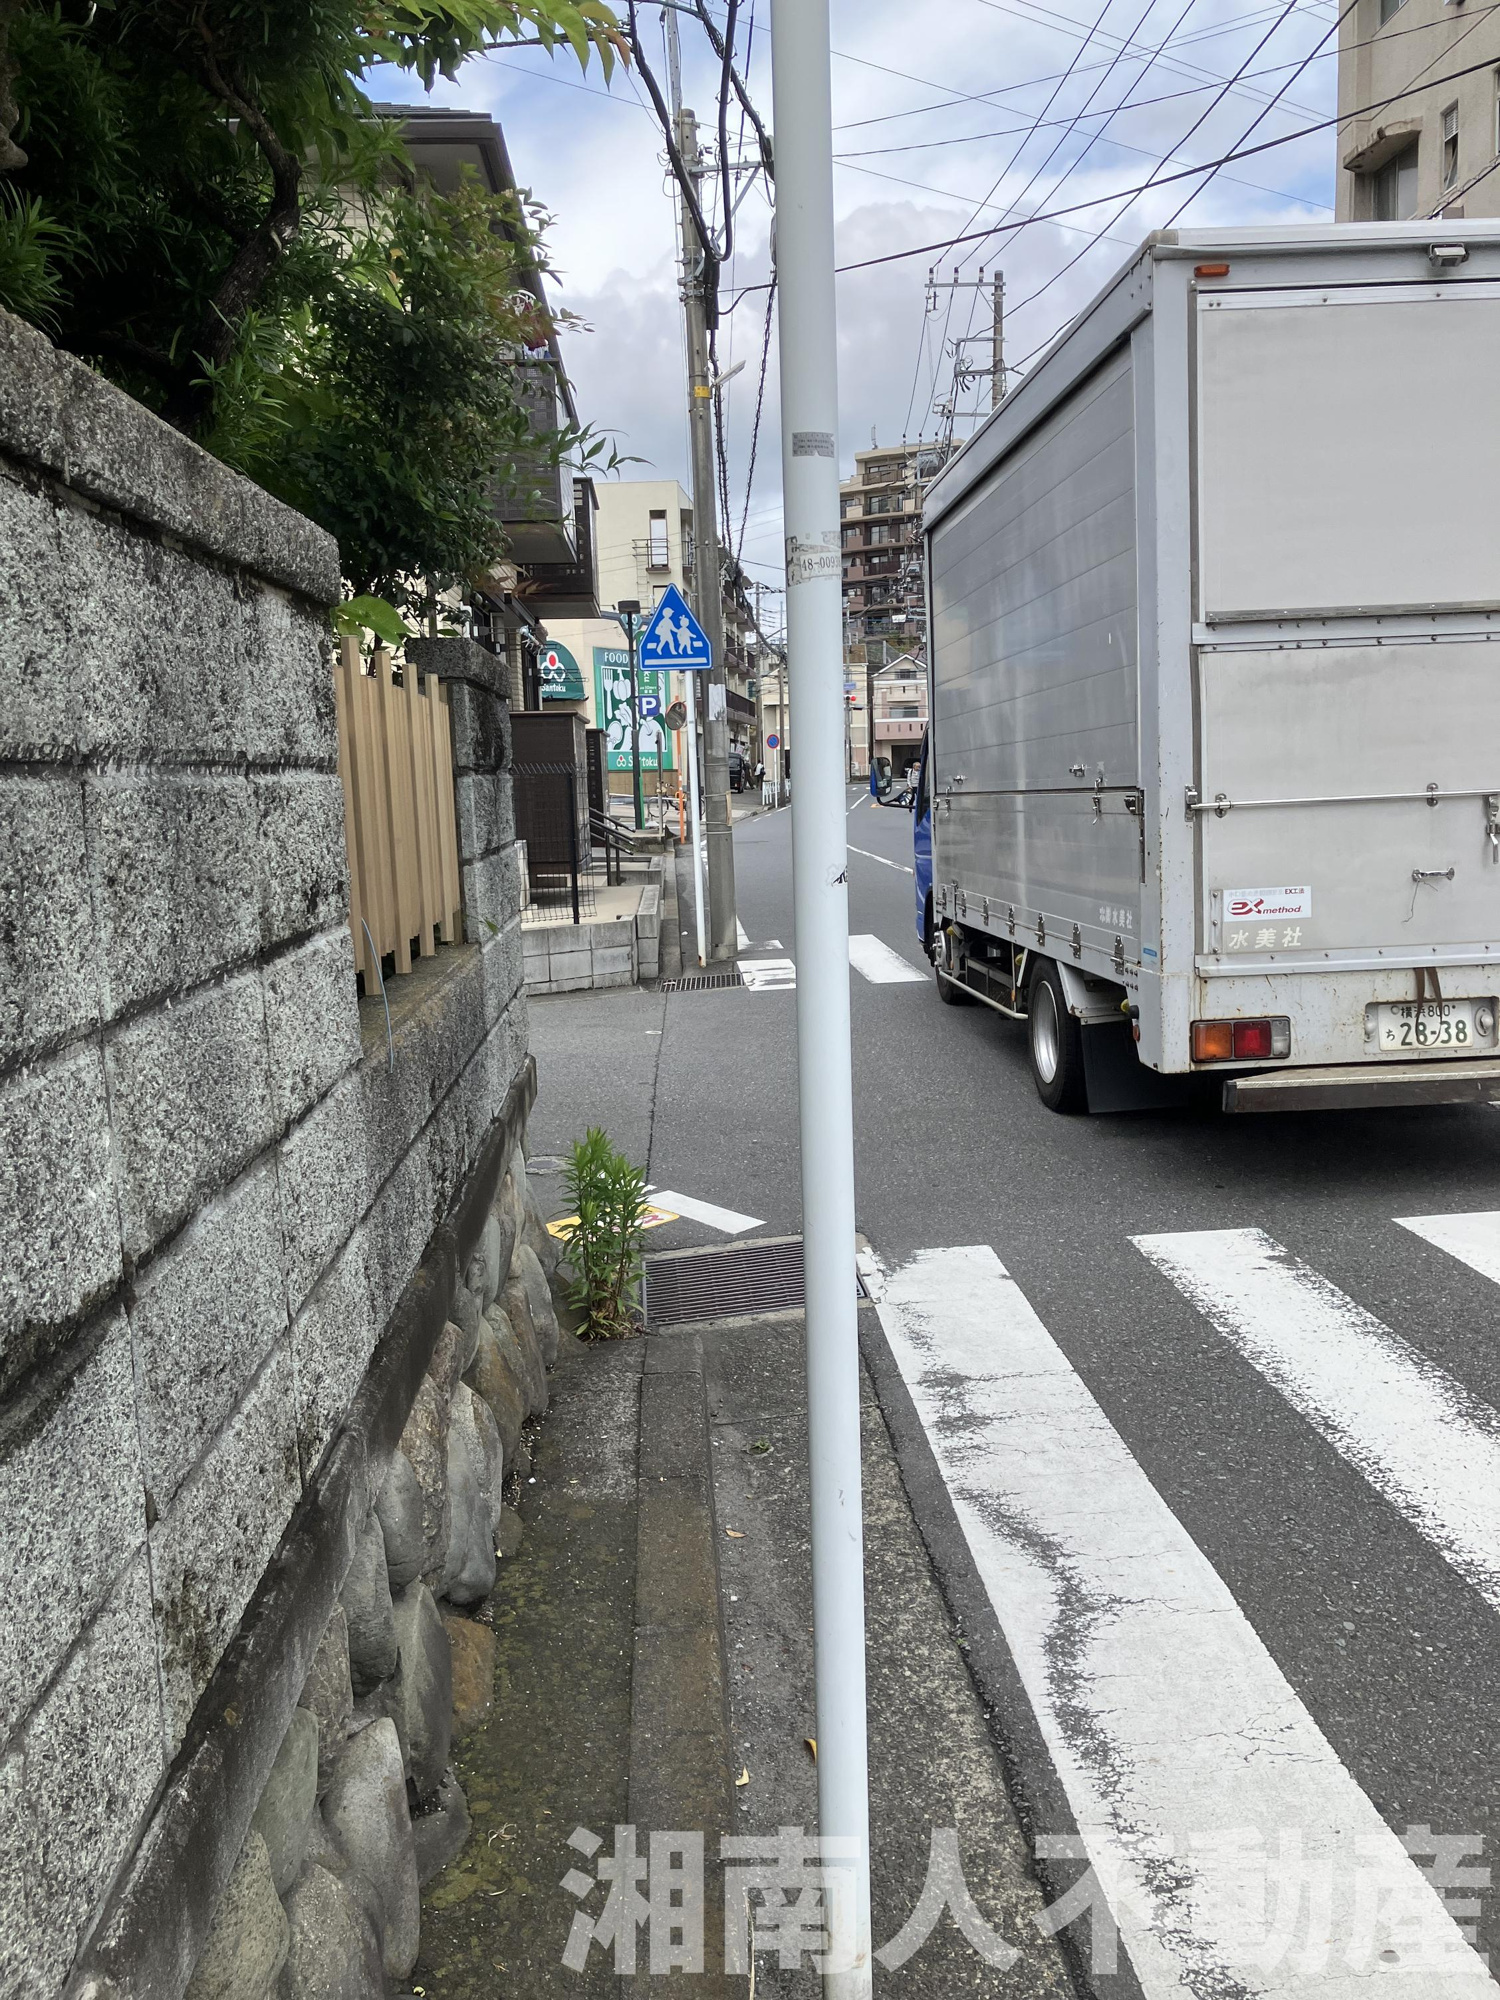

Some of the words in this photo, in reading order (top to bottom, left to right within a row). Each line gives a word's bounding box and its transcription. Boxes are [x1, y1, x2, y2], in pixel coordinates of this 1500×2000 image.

[604, 652, 629, 663] FOOD
[642, 697, 657, 715] P
[1262, 905, 1302, 915] method
[1228, 926, 1303, 949] 水美社
[1399, 1019, 1468, 1047] 28-38
